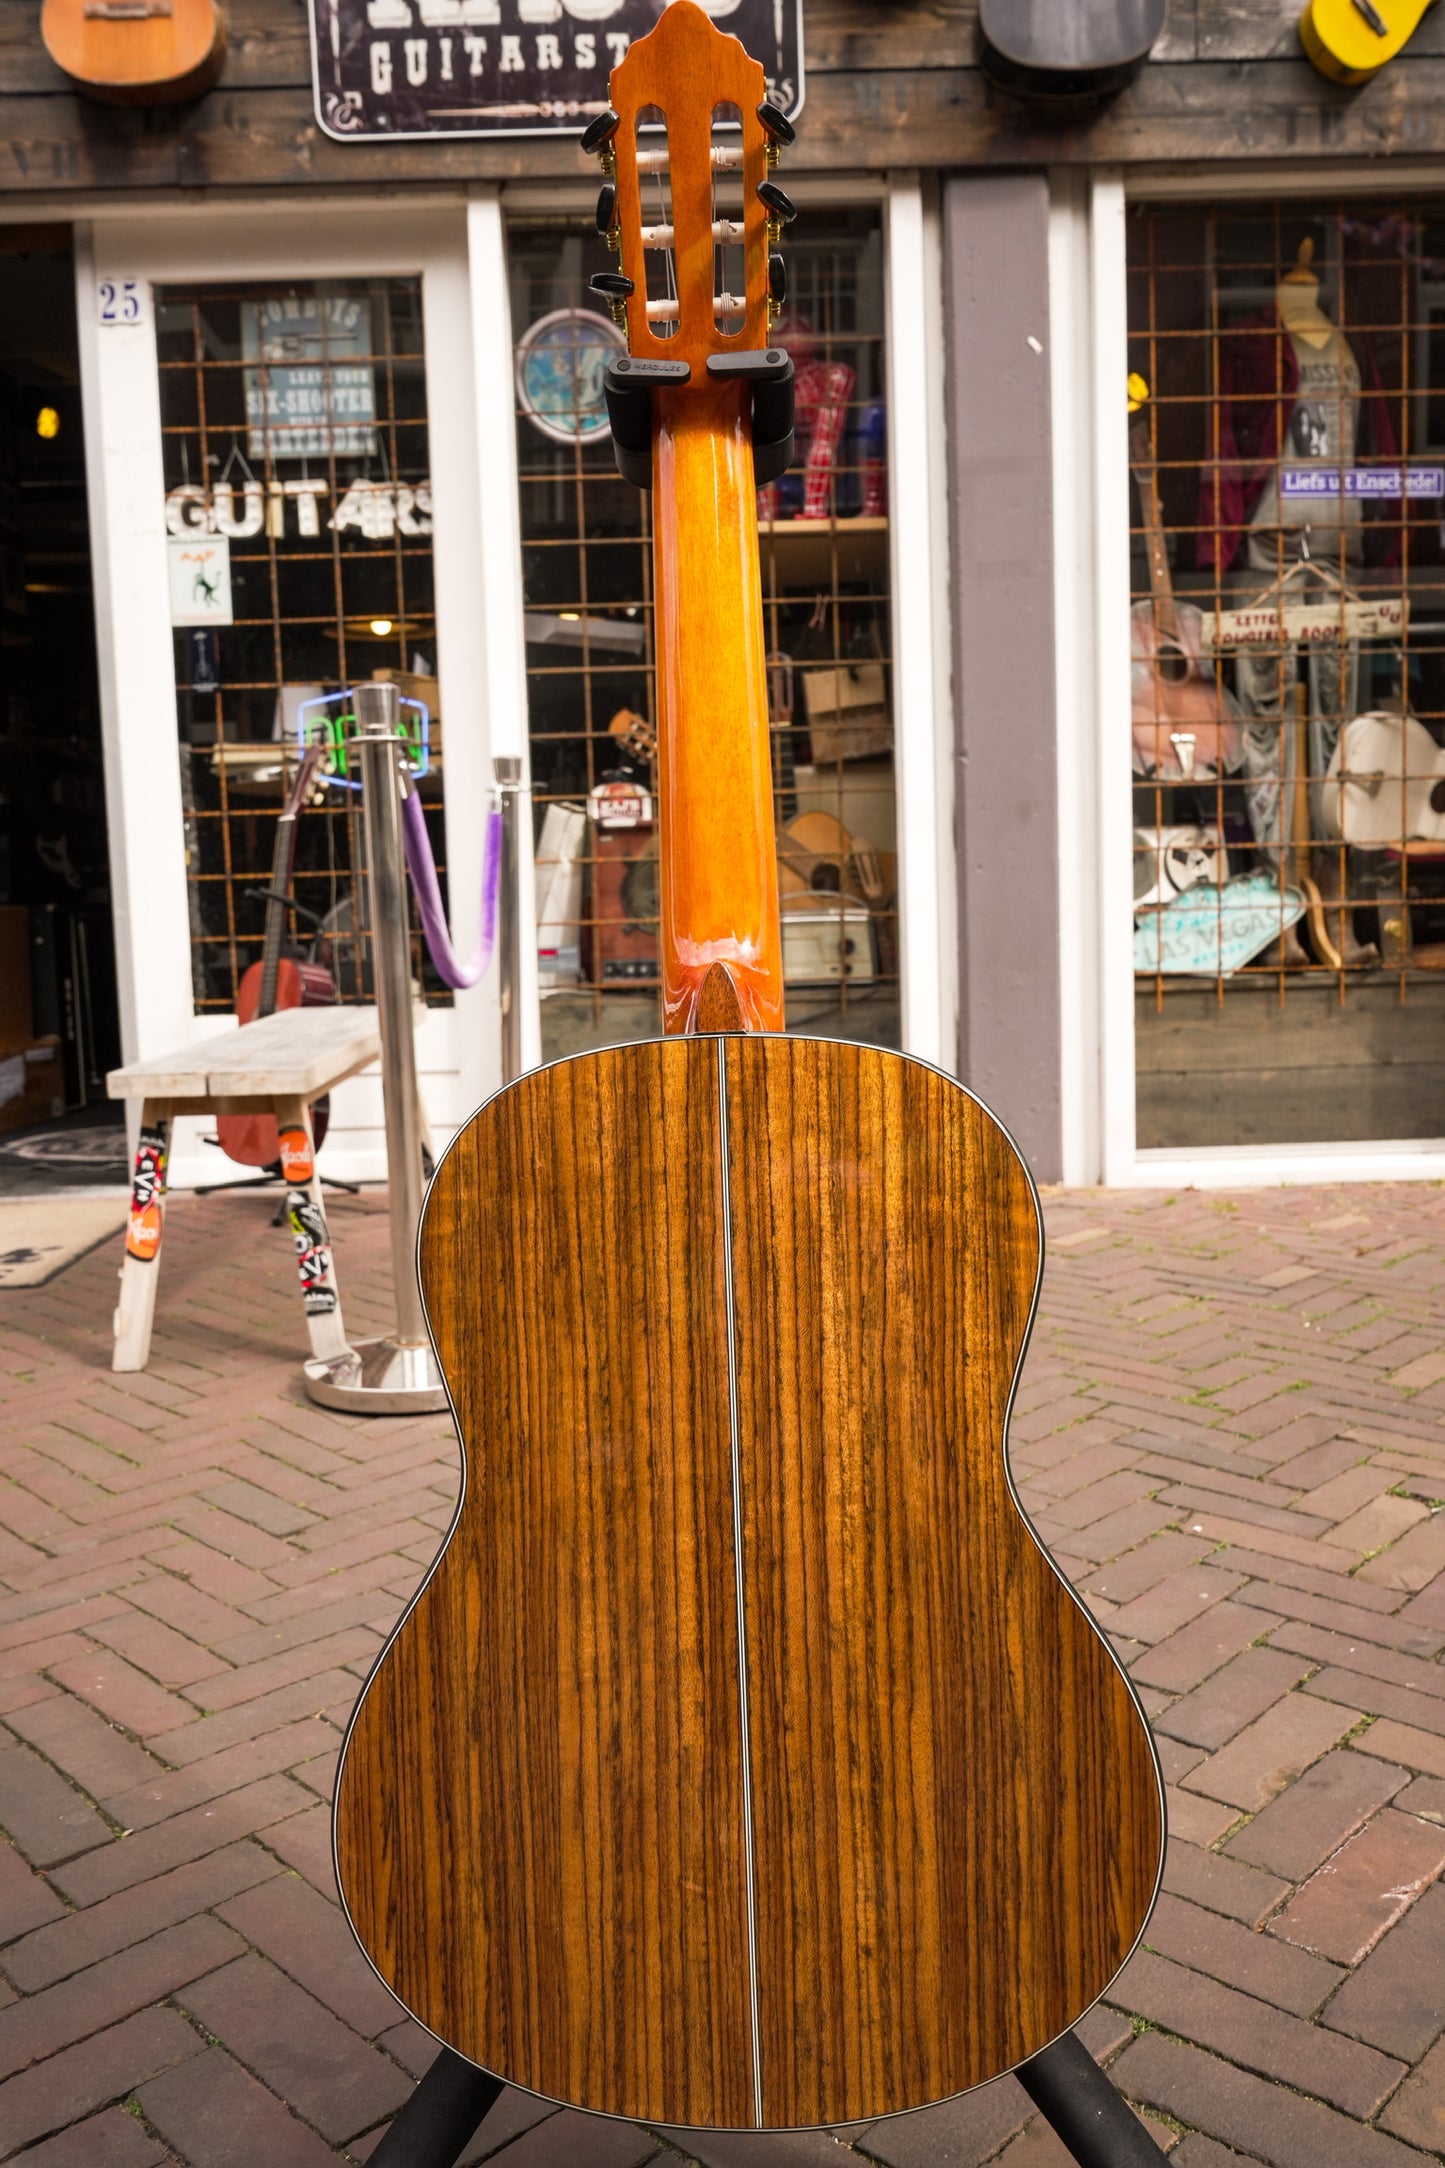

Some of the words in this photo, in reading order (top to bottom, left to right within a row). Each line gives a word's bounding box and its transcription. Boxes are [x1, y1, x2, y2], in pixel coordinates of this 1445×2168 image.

[370, 32, 736, 95] GUITARST
[100, 283, 139, 319] 25
[289, 369, 323, 384] LEAV
[634, 363, 681, 372] HERCULES
[1285, 473, 1326, 490] Liefs
[1328, 476, 1353, 490] ut
[165, 479, 433, 540] GUITARS
[1211, 628, 1288, 645] COWGIRS
[306, 714, 424, 775] OPN
[1144, 934, 1191, 966] LAS
[1197, 910, 1282, 947] VEGAS
[134, 1159, 156, 1202] EVH
